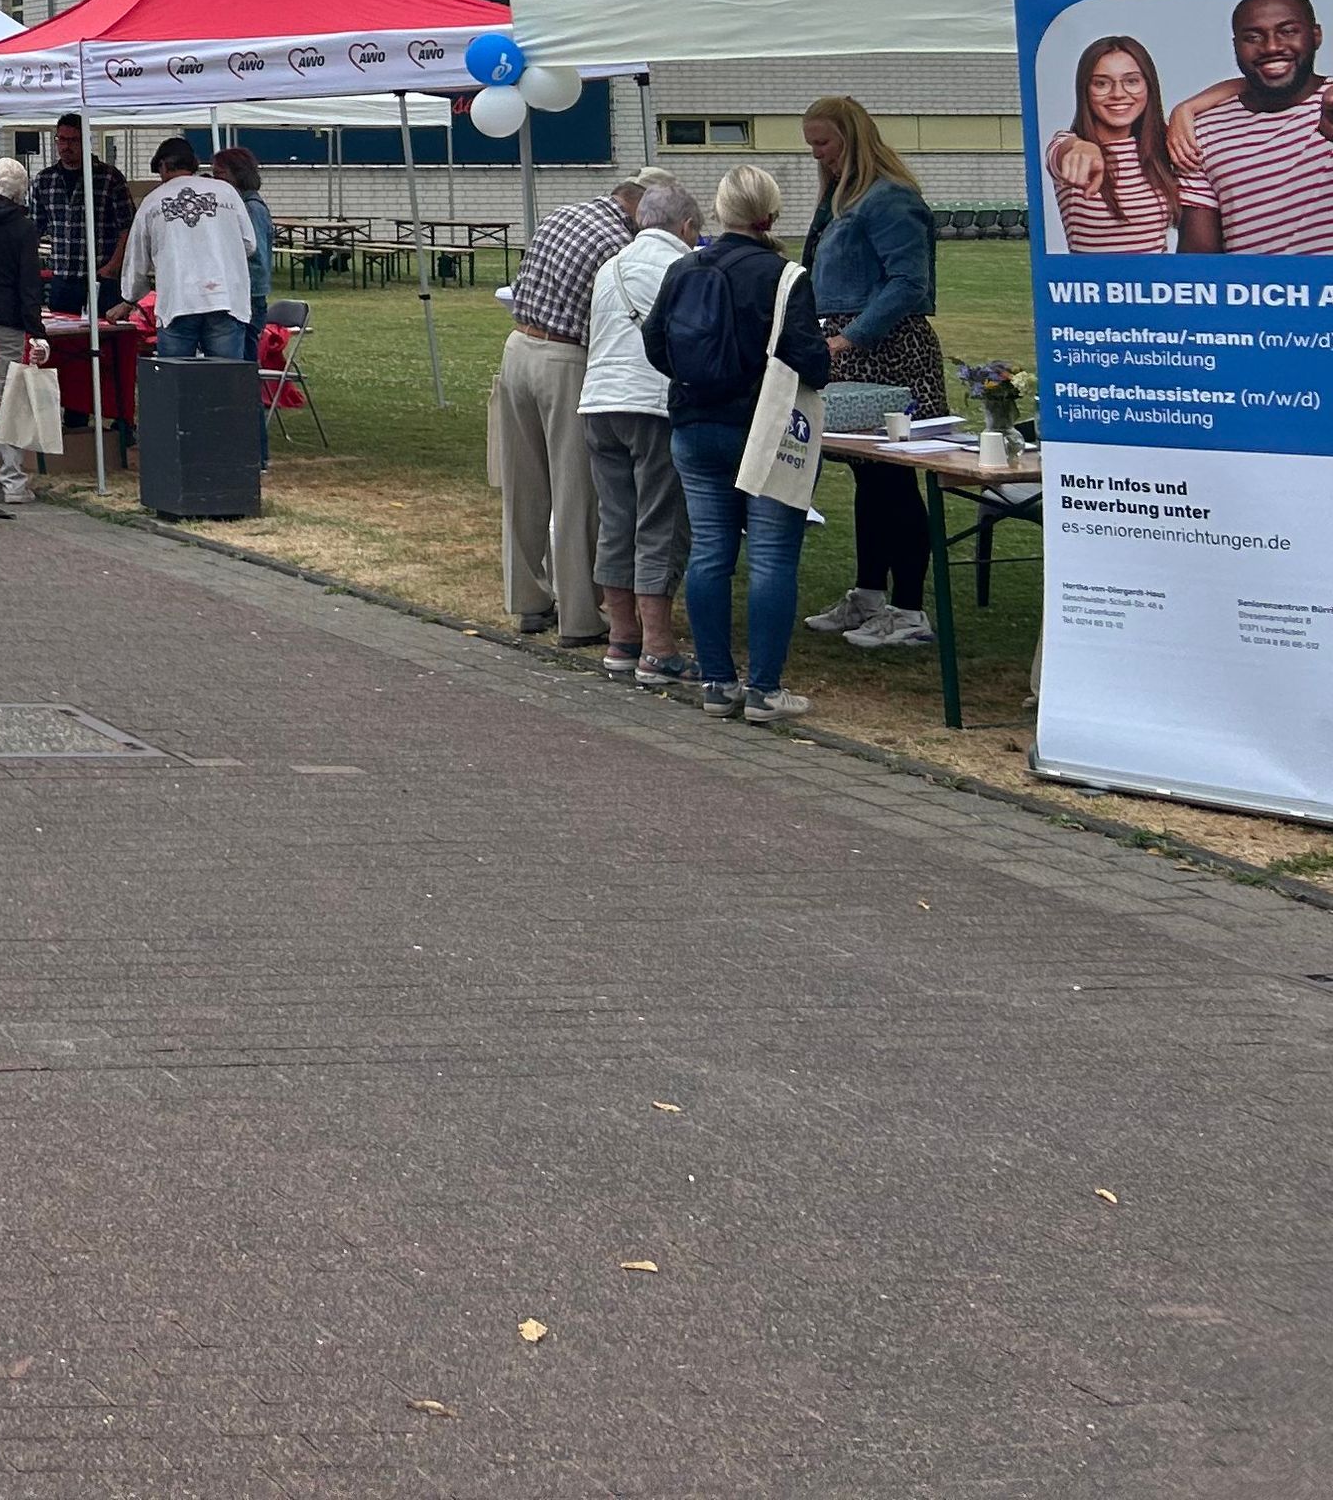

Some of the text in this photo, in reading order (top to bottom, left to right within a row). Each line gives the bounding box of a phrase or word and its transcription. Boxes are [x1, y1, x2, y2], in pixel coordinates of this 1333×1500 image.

[298, 55, 325, 67] AWO
[358, 51, 385, 63] AWO
[418, 48, 445, 60] AWO
[115, 66, 143, 77] AWO
[176, 63, 204, 75] AWO
[237, 59, 264, 71] AWO
[1048, 282, 1100, 304] WIR
[1106, 282, 1217, 305] BILDEN
[1226, 283, 1309, 307] DICH
[1051, 327, 1254, 346] Pflegefachfrau/-mann
[1053, 349, 1216, 370] 3-jährige Ausbildung
[1055, 382, 1321, 410] Pflegefachassistenz (m/w/d)
[1057, 405, 1213, 429] 1-jährige Ausbildung
[1060, 474, 1188, 495] Mehr Infos und
[1061, 496, 1211, 519] Bewerbung unter
[1062, 521, 1291, 550] es-senioreneinrichtungen.de
[1084, 607, 1125, 617] Leverkusen
[1261, 626, 1306, 636] Leverkusen
